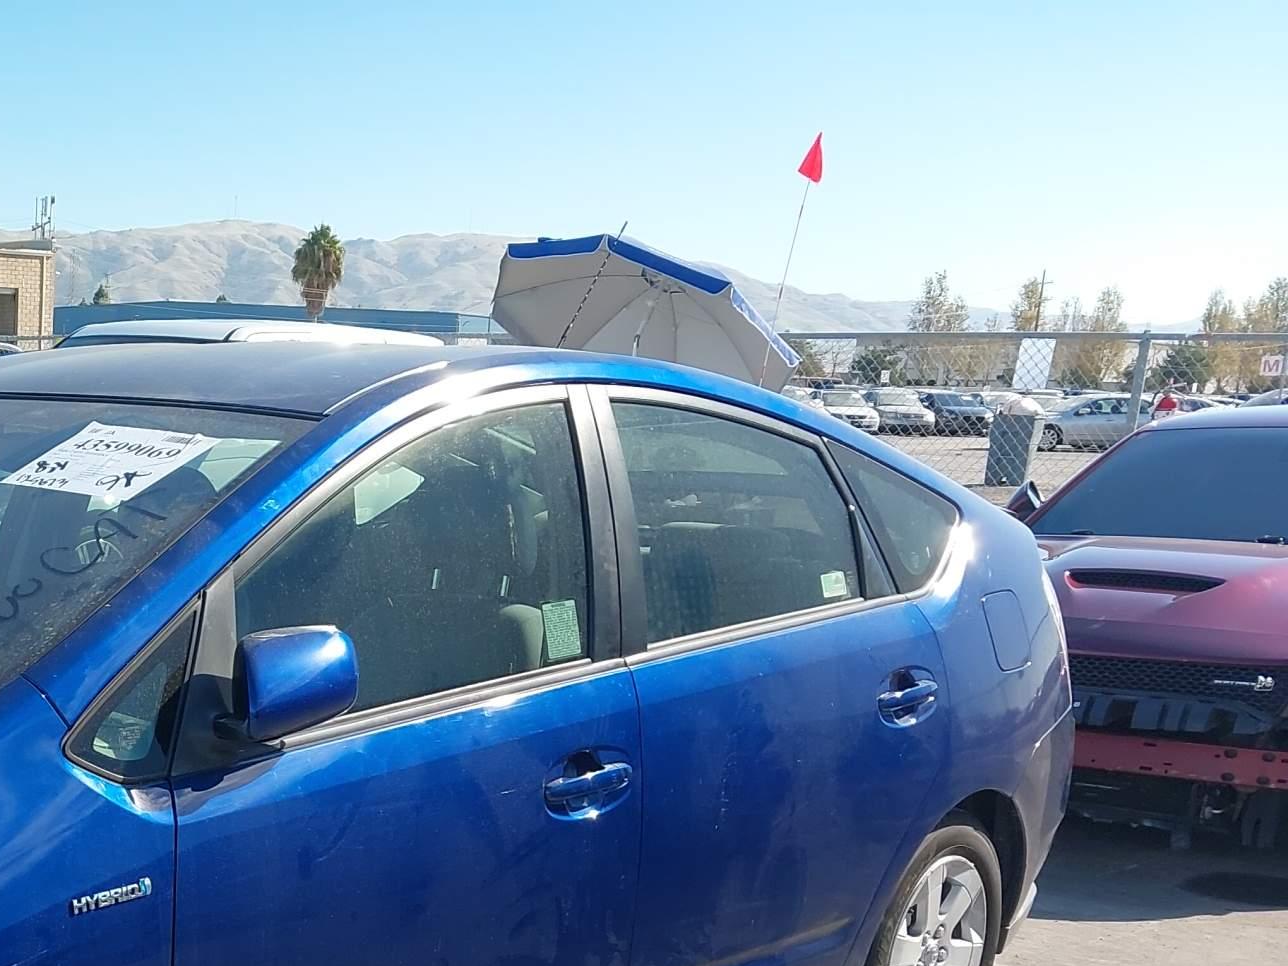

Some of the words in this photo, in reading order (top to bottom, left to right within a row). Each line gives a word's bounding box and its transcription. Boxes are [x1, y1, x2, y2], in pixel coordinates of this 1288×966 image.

[1263, 359, 1280, 373] M
[73, 438, 182, 460] 43599069
[71, 883, 145, 915] HYBRID
